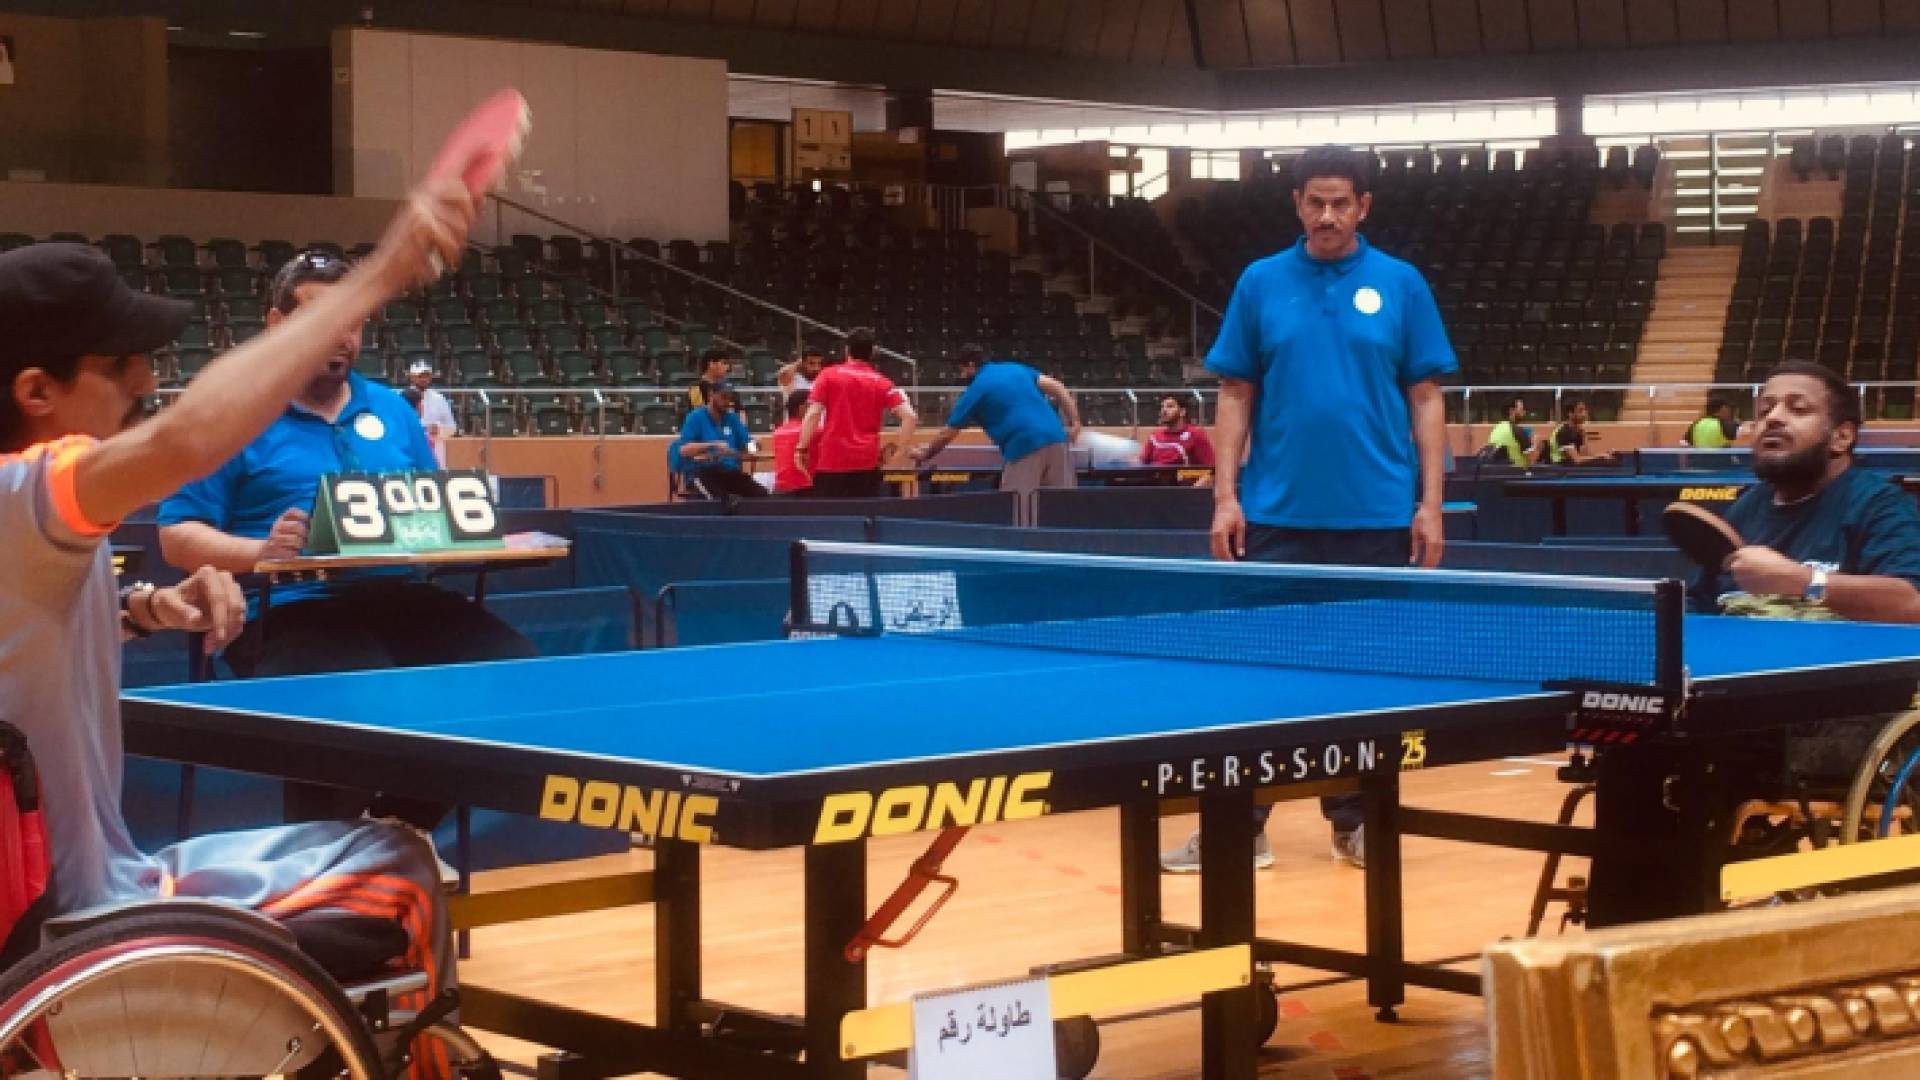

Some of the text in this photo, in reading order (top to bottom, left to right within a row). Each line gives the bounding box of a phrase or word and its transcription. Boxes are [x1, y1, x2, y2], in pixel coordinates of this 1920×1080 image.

[335, 480, 386, 538] 3
[447, 477, 495, 532] 6
[1680, 487, 1738, 500] DONIC
[1582, 691, 1664, 714] DONIC
[1401, 736, 1427, 765] 25
[540, 774, 719, 845] DONIC
[813, 771, 1053, 846] DONIC
[938, 999, 1031, 1053] طاولة رقم
